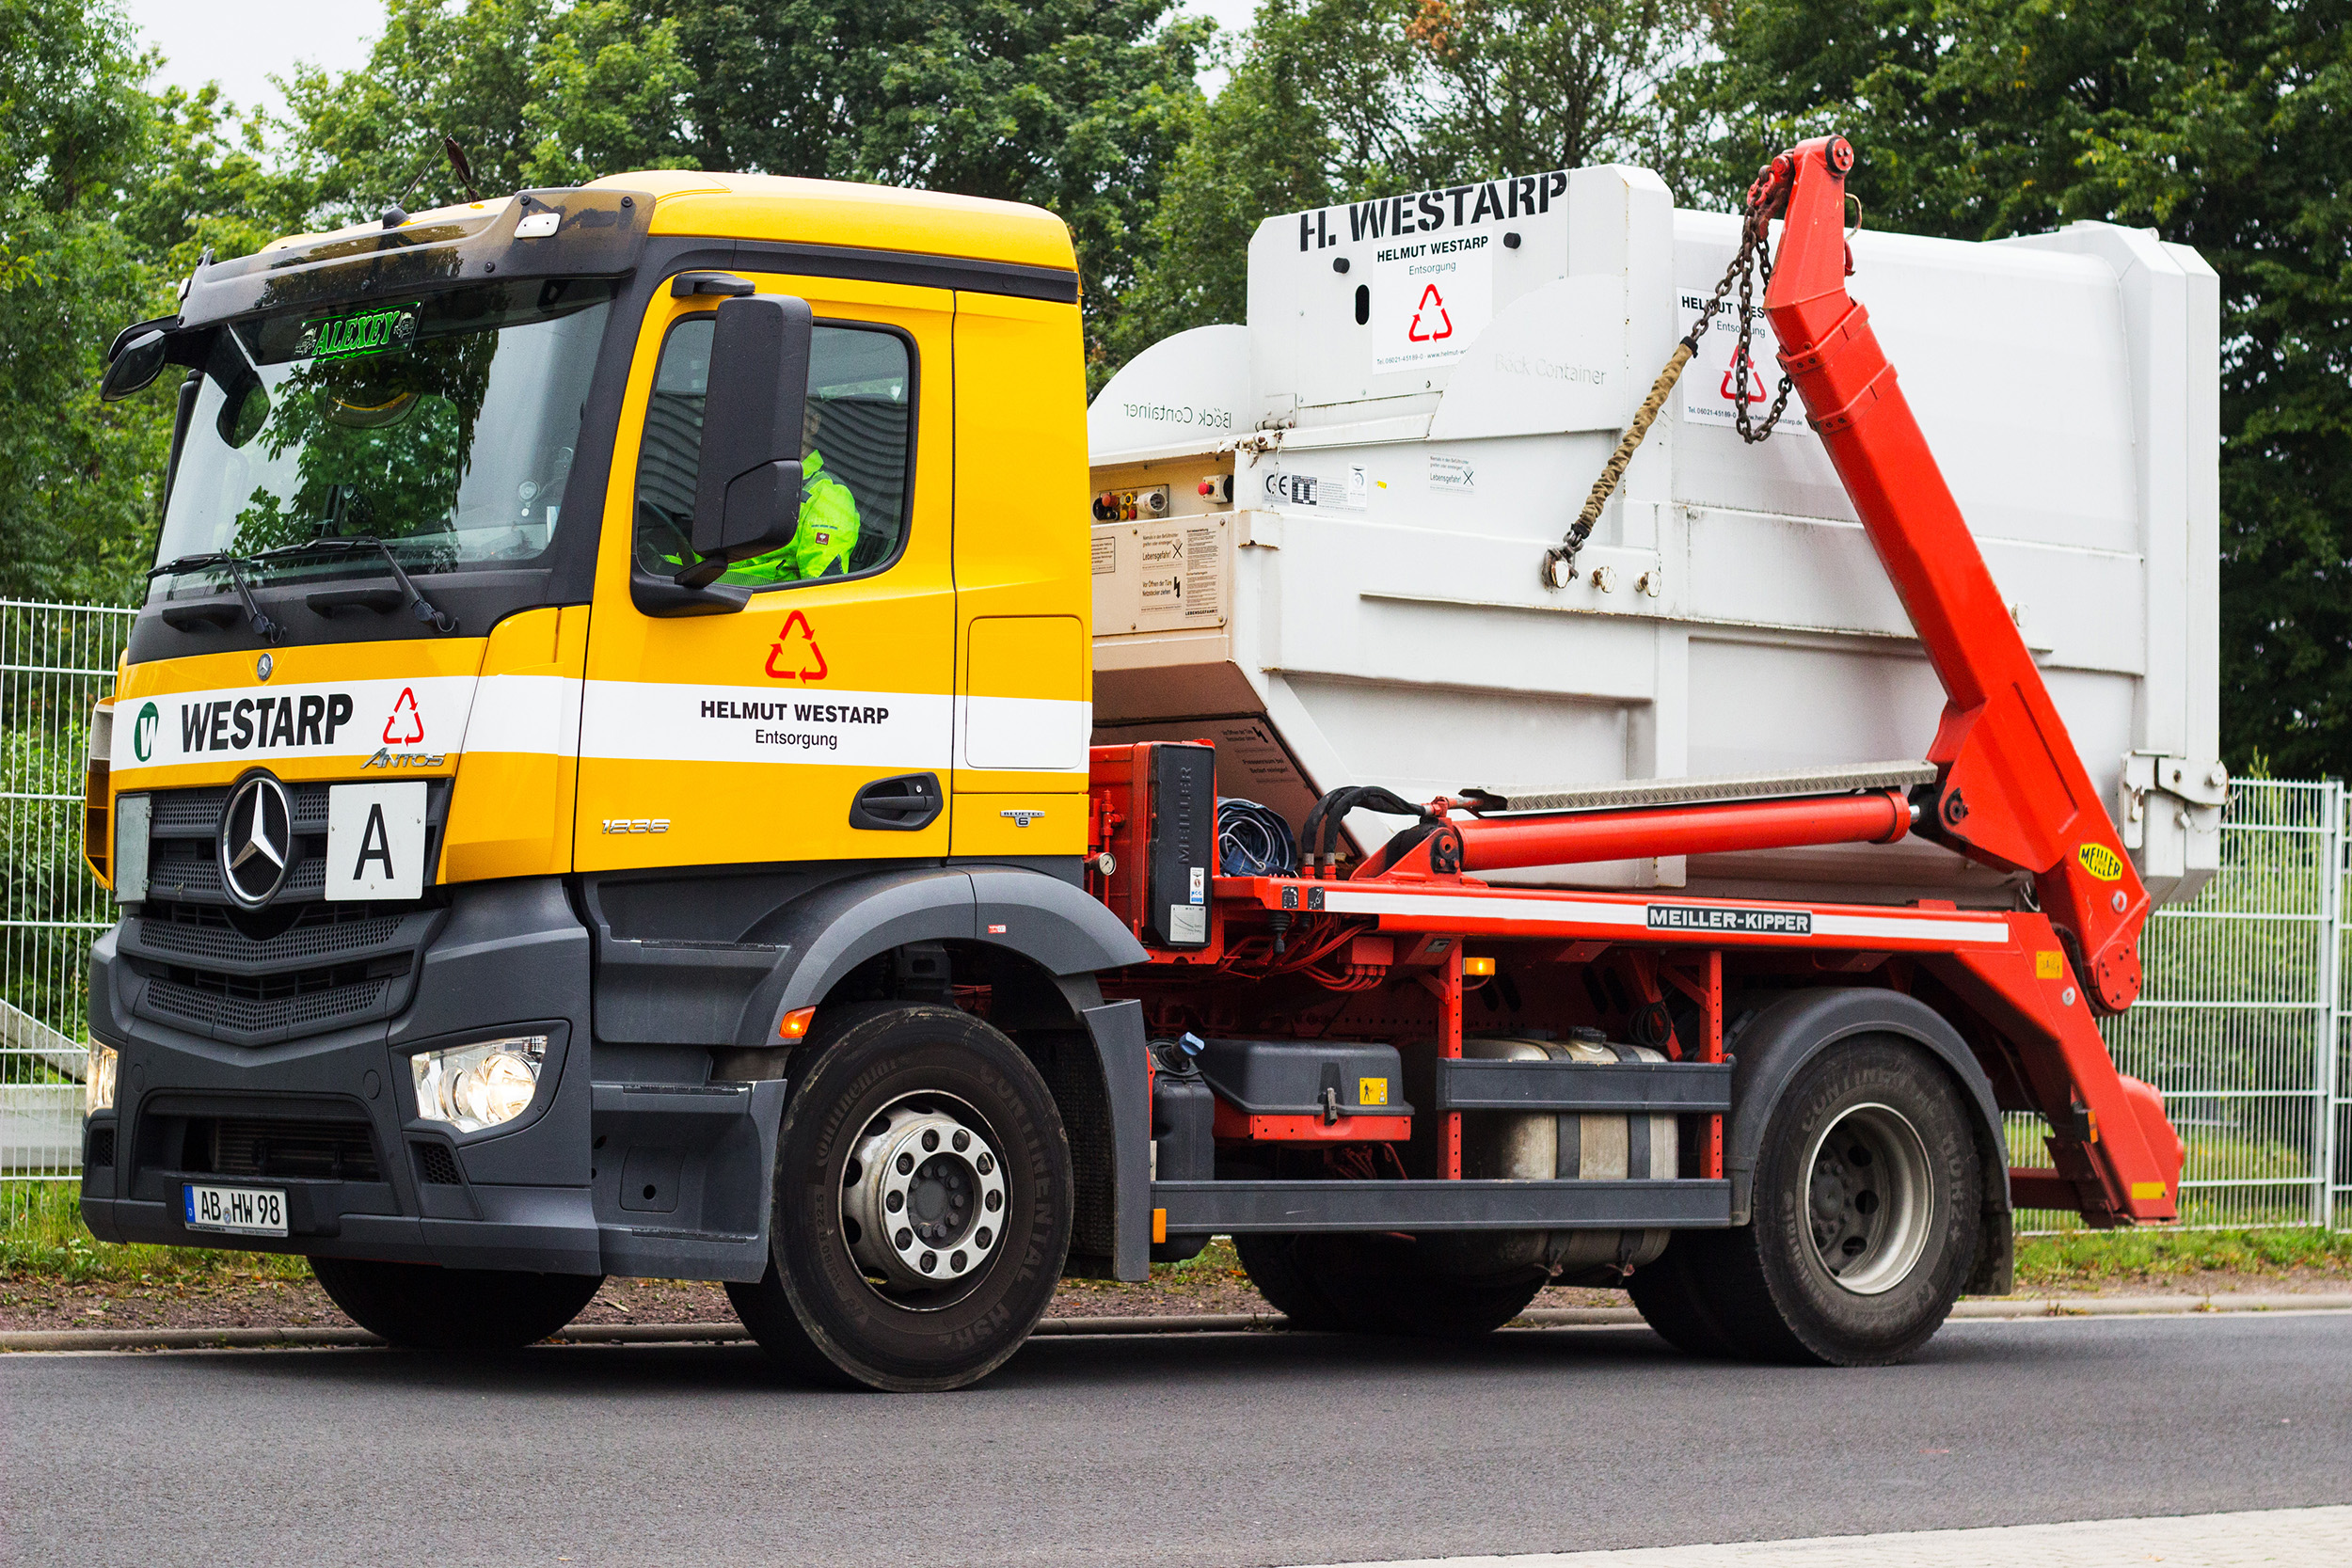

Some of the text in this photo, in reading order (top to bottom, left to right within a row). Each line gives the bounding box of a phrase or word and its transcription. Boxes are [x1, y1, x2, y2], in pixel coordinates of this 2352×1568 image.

[1300, 172, 1567, 252] H. WESTARP
[1377, 235, 1488, 262] HELMUT WESTARP
[1409, 261, 1456, 276] Entsorgung
[1681, 295, 1733, 314] HELUT
[311, 310, 401, 356] ALEXEY
[1716, 321, 1766, 339] Entsoung
[1535, 357, 1607, 385] Container
[1696, 407, 1737, 420] 06021-45189-0
[1265, 474, 1288, 497] CE
[182, 693, 354, 752] WESTARP
[700, 701, 890, 724] HELMUT WESTARP
[755, 729, 838, 751] Entsorgung
[359, 746, 447, 769] ANTOS
[602, 819, 671, 834] 1836
[1018, 816, 1028, 826] 6
[1178, 767, 1192, 864] MEILLER
[353, 802, 395, 880] A
[2081, 847, 2121, 877] MEILLER
[1649, 909, 1808, 931] MEILLER-KIPPER
[201, 1191, 280, 1225] AB HW 98
[816, 1194, 825, 1227] 22.5
